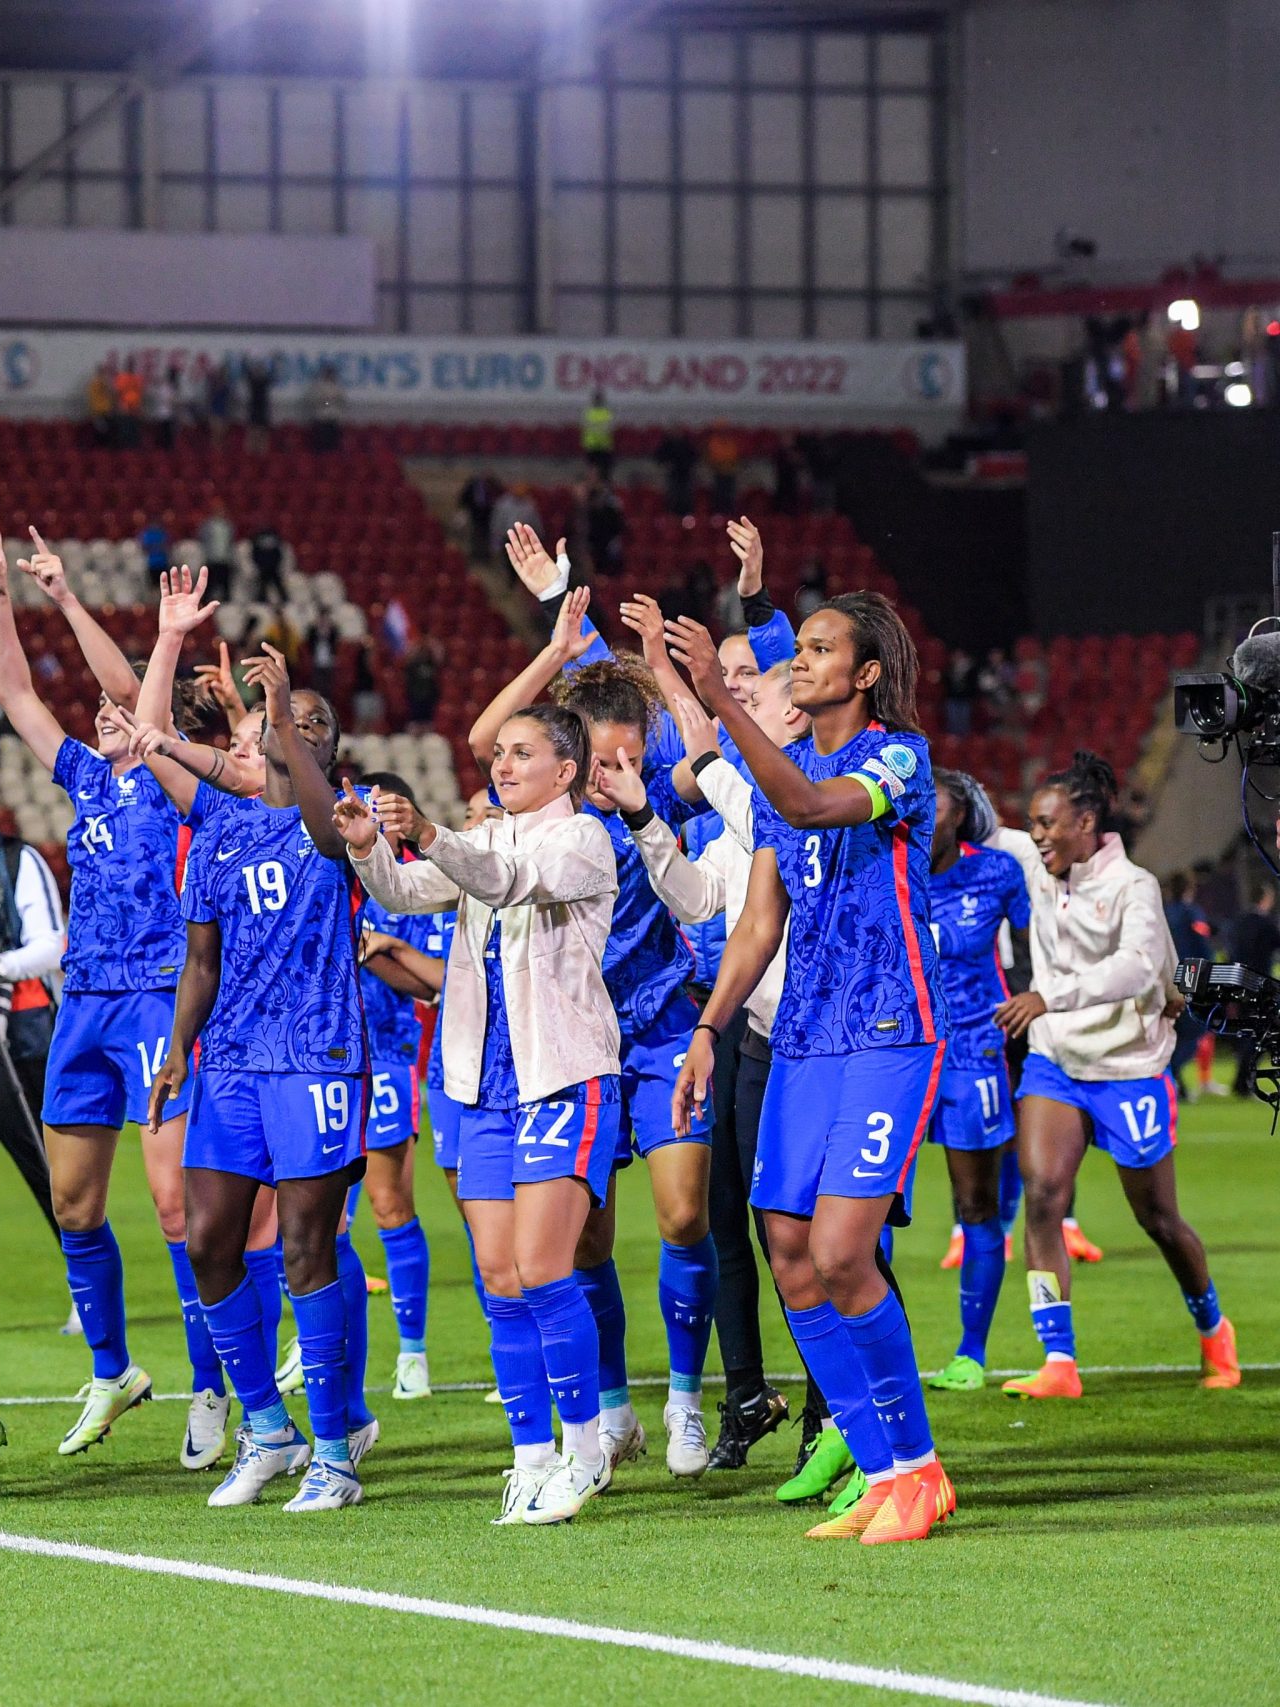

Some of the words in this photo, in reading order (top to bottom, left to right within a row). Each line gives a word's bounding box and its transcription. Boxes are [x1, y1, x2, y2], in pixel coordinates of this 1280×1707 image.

[431, 352, 546, 391] EURO
[554, 354, 750, 393] ENGLAND
[754, 355, 848, 395] 2022
[82, 814, 114, 855] 14
[803, 835, 822, 888] 3
[241, 860, 288, 915] 19
[308, 1081, 348, 1134] 19
[975, 1076, 999, 1118] 11
[1119, 1096, 1161, 1141] 12
[517, 1100, 575, 1147] 22
[860, 1111, 893, 1165] 3
